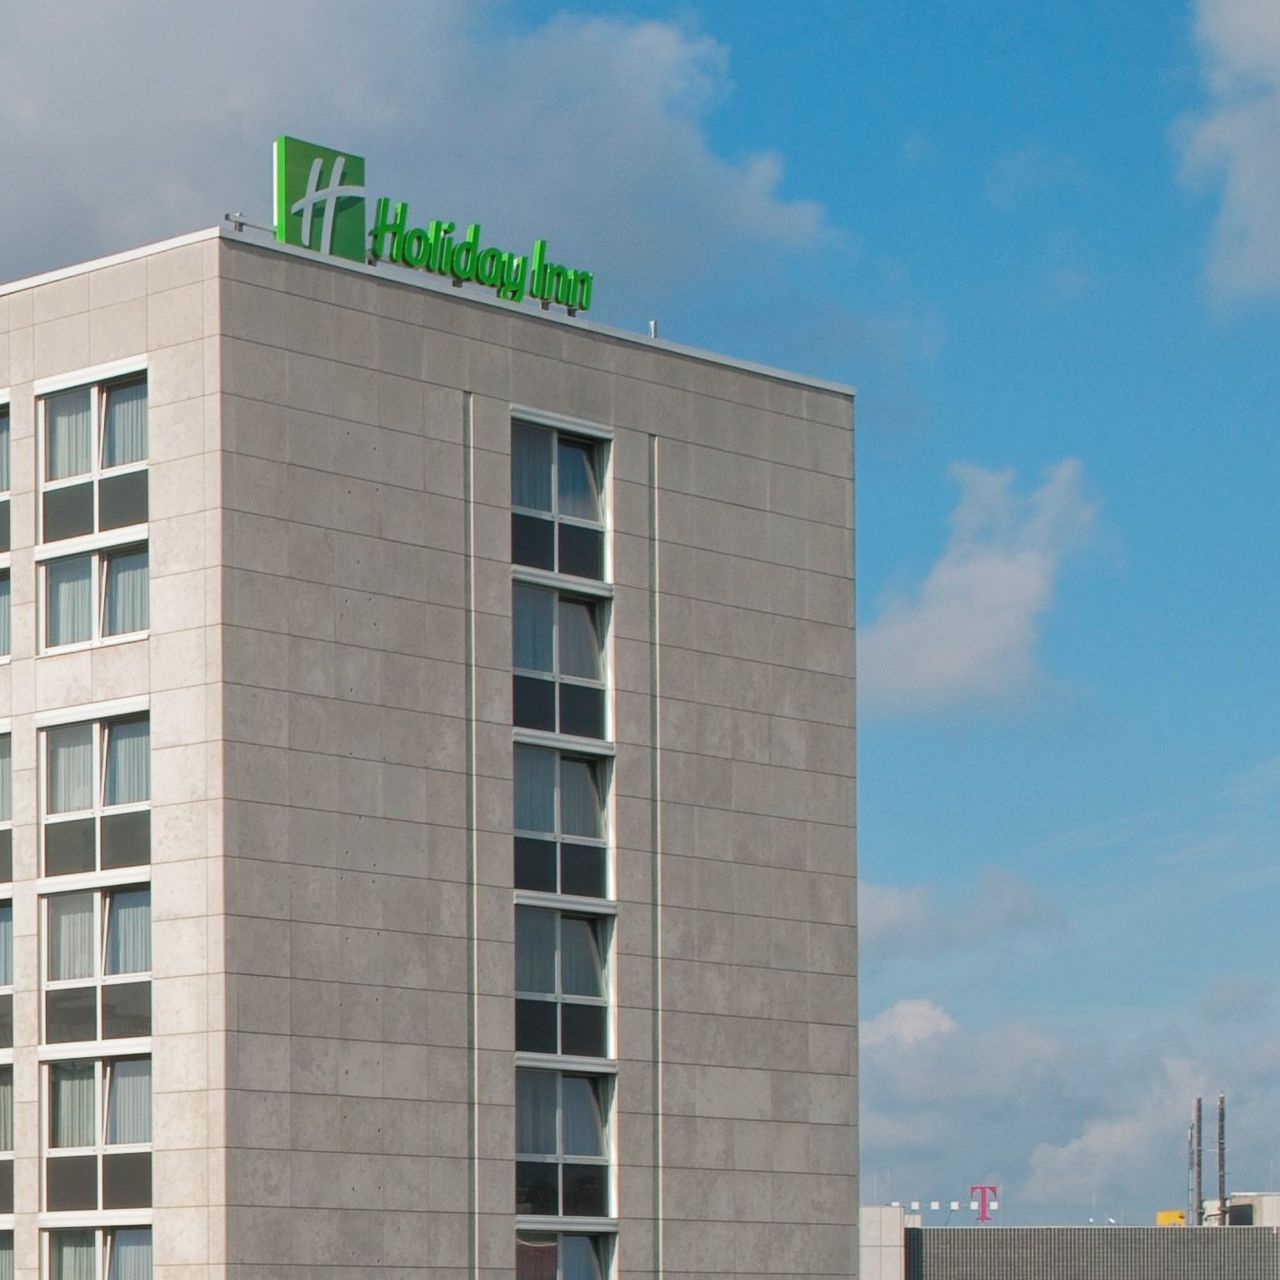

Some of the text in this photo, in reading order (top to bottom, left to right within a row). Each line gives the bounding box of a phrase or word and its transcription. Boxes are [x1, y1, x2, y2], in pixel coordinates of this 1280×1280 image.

[369, 197, 593, 310] Holiday Inn
[970, 1186, 997, 1221] T
